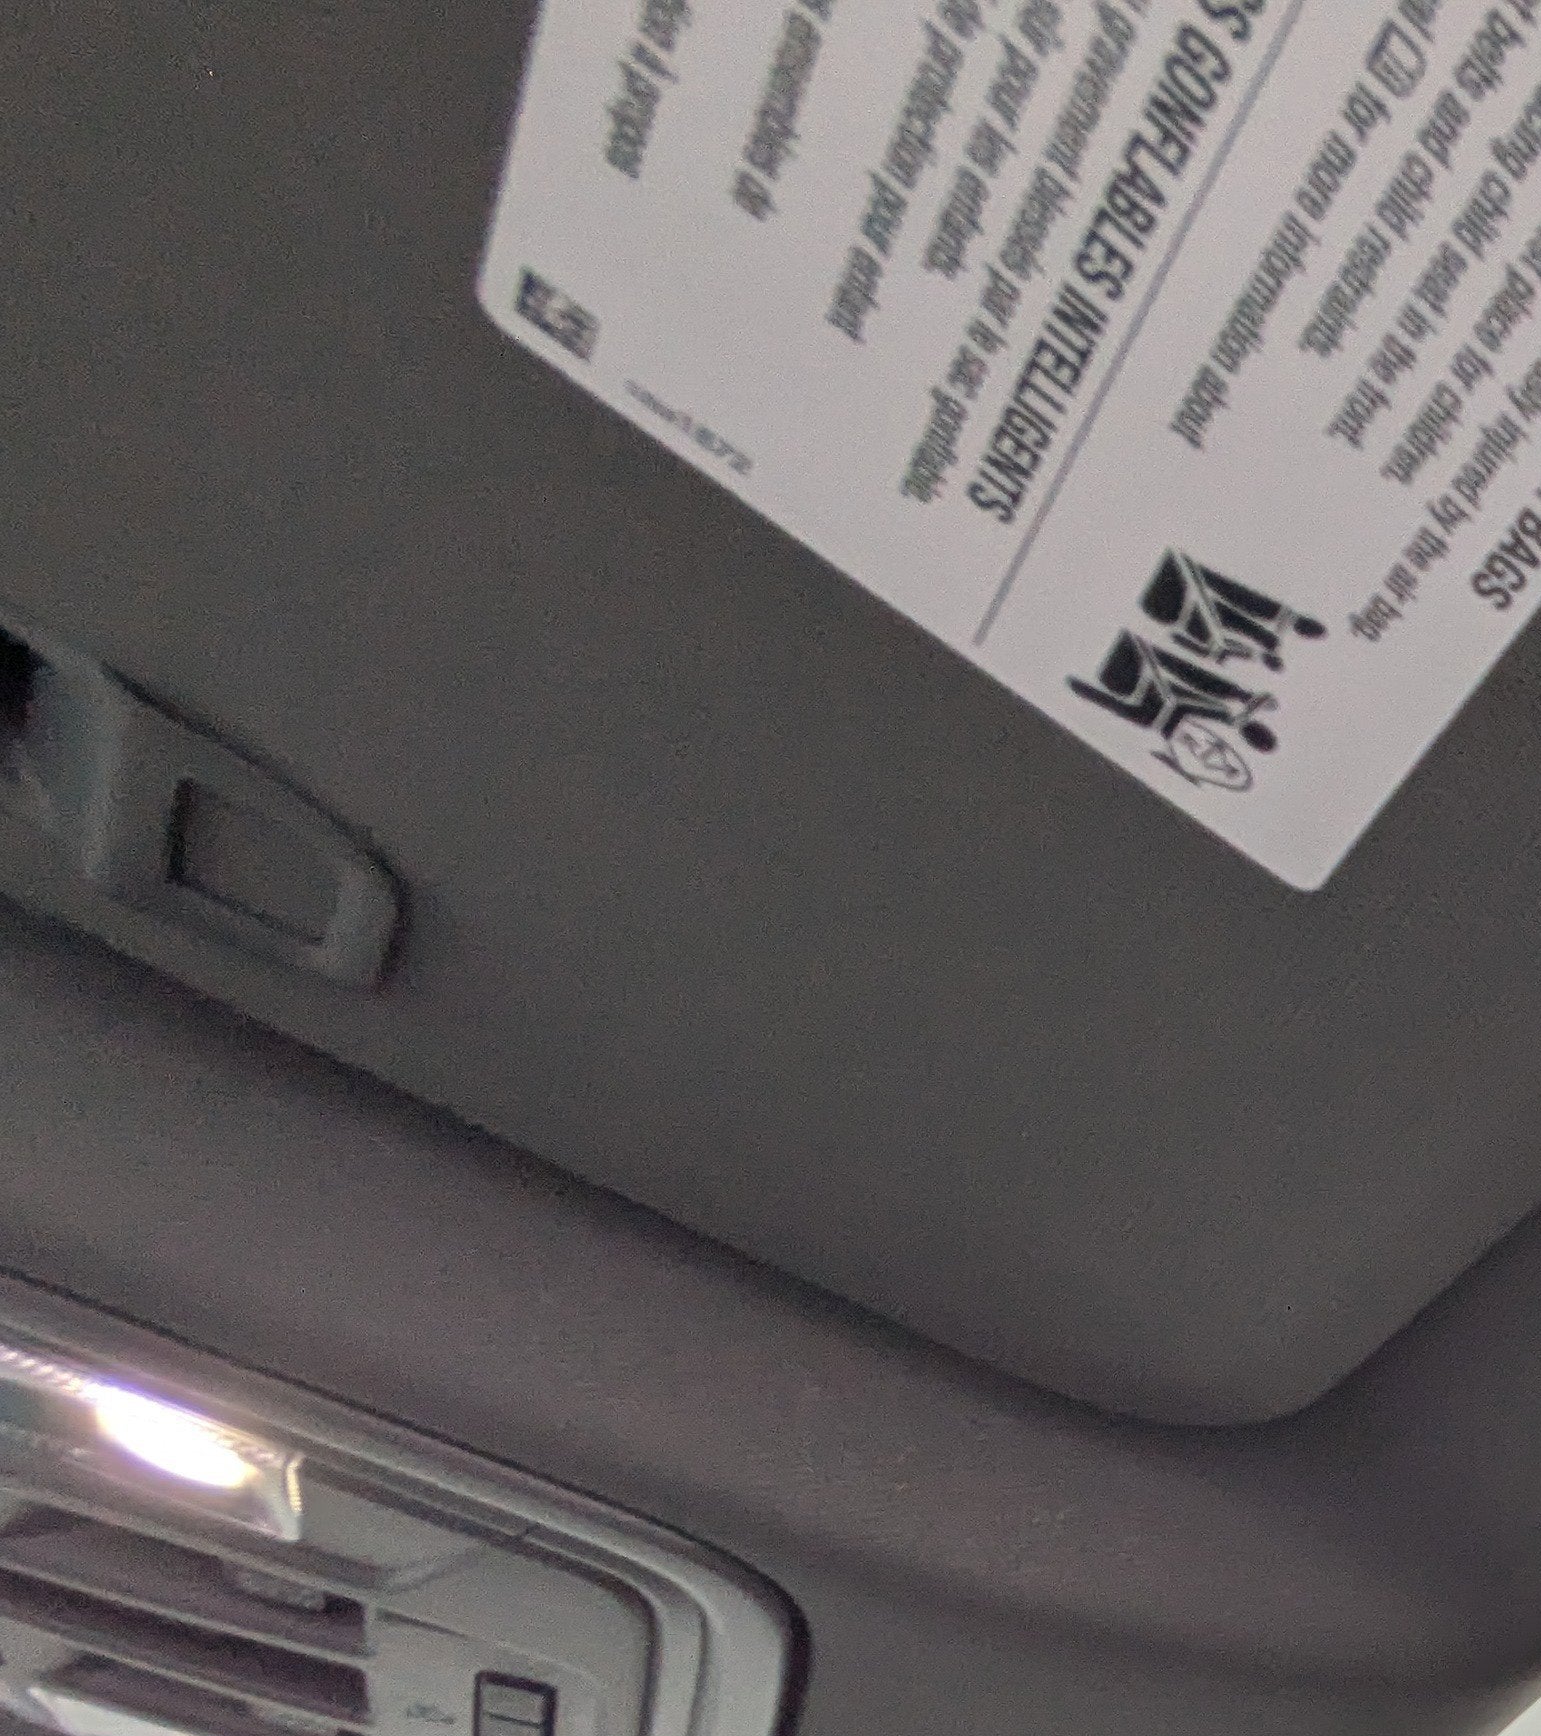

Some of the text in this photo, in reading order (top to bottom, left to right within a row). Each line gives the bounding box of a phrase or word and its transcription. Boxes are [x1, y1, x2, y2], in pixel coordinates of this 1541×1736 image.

[1452, 7, 1525, 100] belts
[1071, 22, 1232, 301] GONFLABLES
[1416, 89, 1470, 170] and
[1374, 151, 1434, 241] child
[1450, 169, 1512, 260] child
[1169, 81, 1391, 450] for more information about
[1299, 223, 1392, 358] restraints.
[1411, 241, 1468, 318] seat
[1395, 303, 1437, 342] in
[1472, 264, 1536, 353] place
[1368, 332, 1417, 385] the
[1449, 343, 1494, 392] for
[966, 282, 1108, 524] INTELLIGENTS
[1326, 377, 1390, 449] front.
[1380, 382, 1462, 485] children.
[1450, 413, 1528, 510] injured
[1402, 526, 1449, 571] the
[1425, 494, 1471, 535] by
[1348, 593, 1401, 642] bag.
[1383, 562, 1418, 605] air
